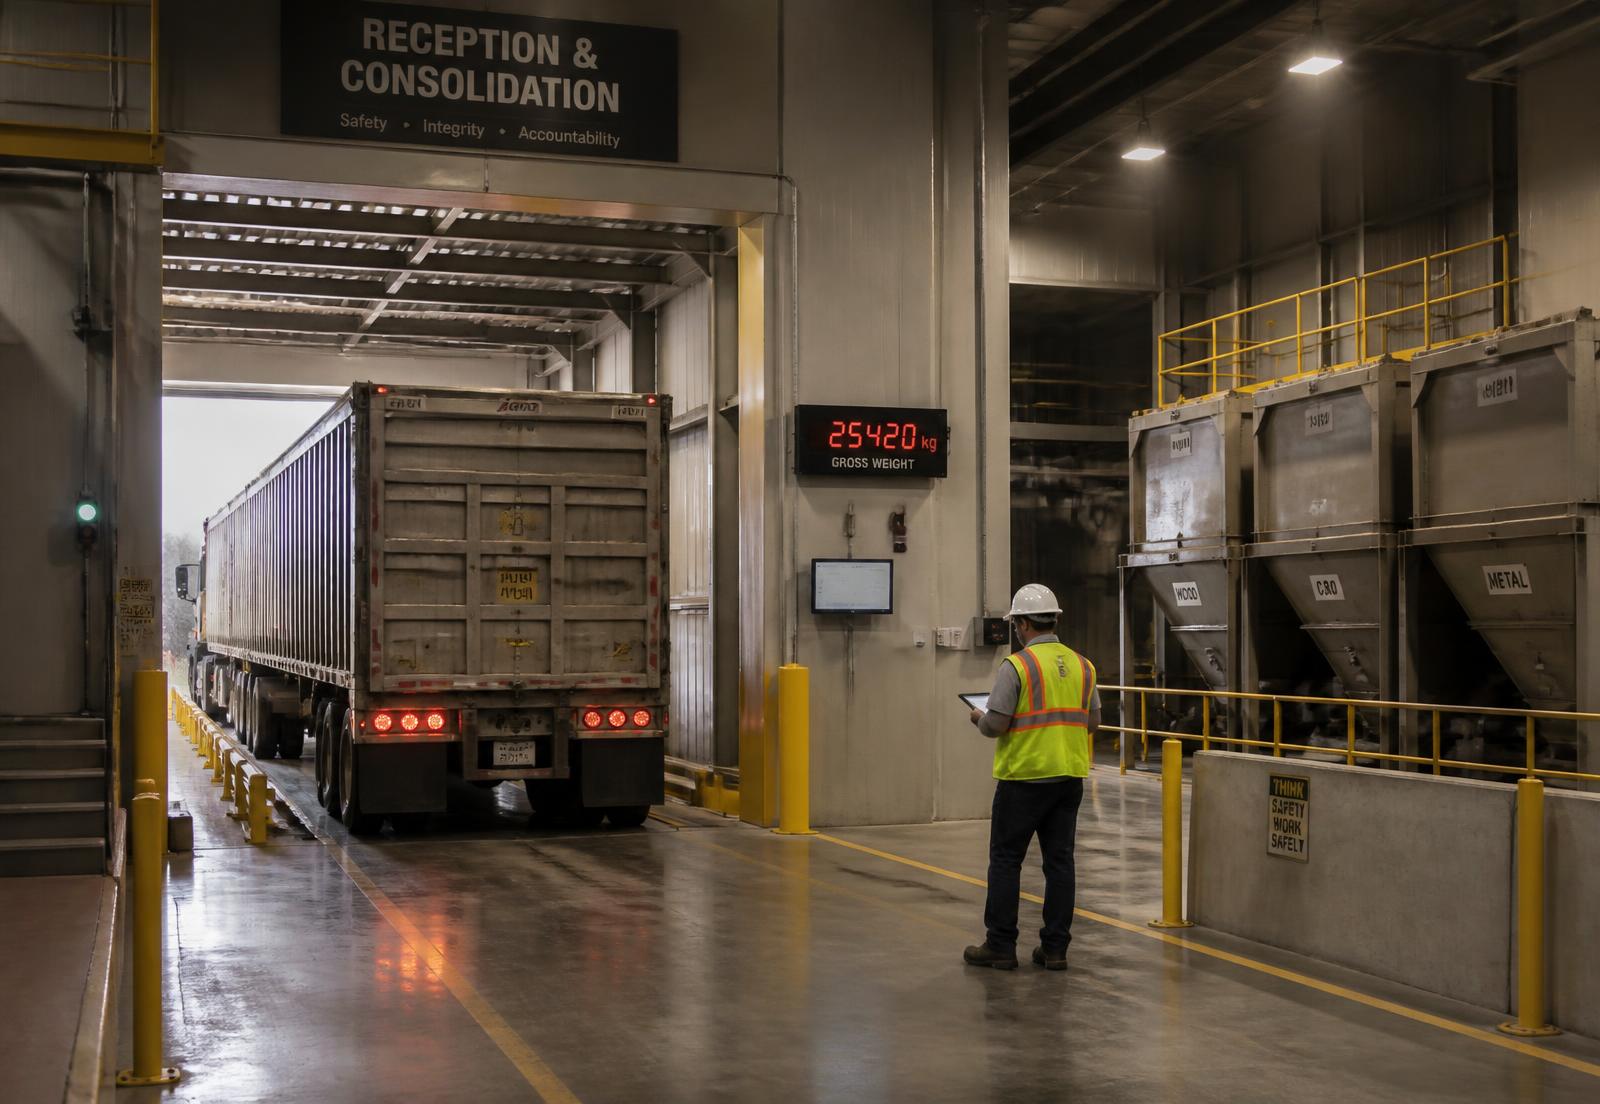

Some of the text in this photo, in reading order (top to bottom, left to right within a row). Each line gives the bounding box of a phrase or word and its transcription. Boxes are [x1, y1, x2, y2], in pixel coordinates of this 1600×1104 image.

[363, 17, 599, 69] RECEPTION &
[341, 59, 620, 113] CONSOLIDATION
[340, 113, 621, 149] Safety Integrity Accountability
[829, 421, 937, 452] 25420 kg
[831, 457, 915, 470] GROSS WEIGHT
[1487, 571, 1528, 590] METAL
[1272, 799, 1305, 818] SAFETY
[1271, 834, 1304, 853] SAFELY
